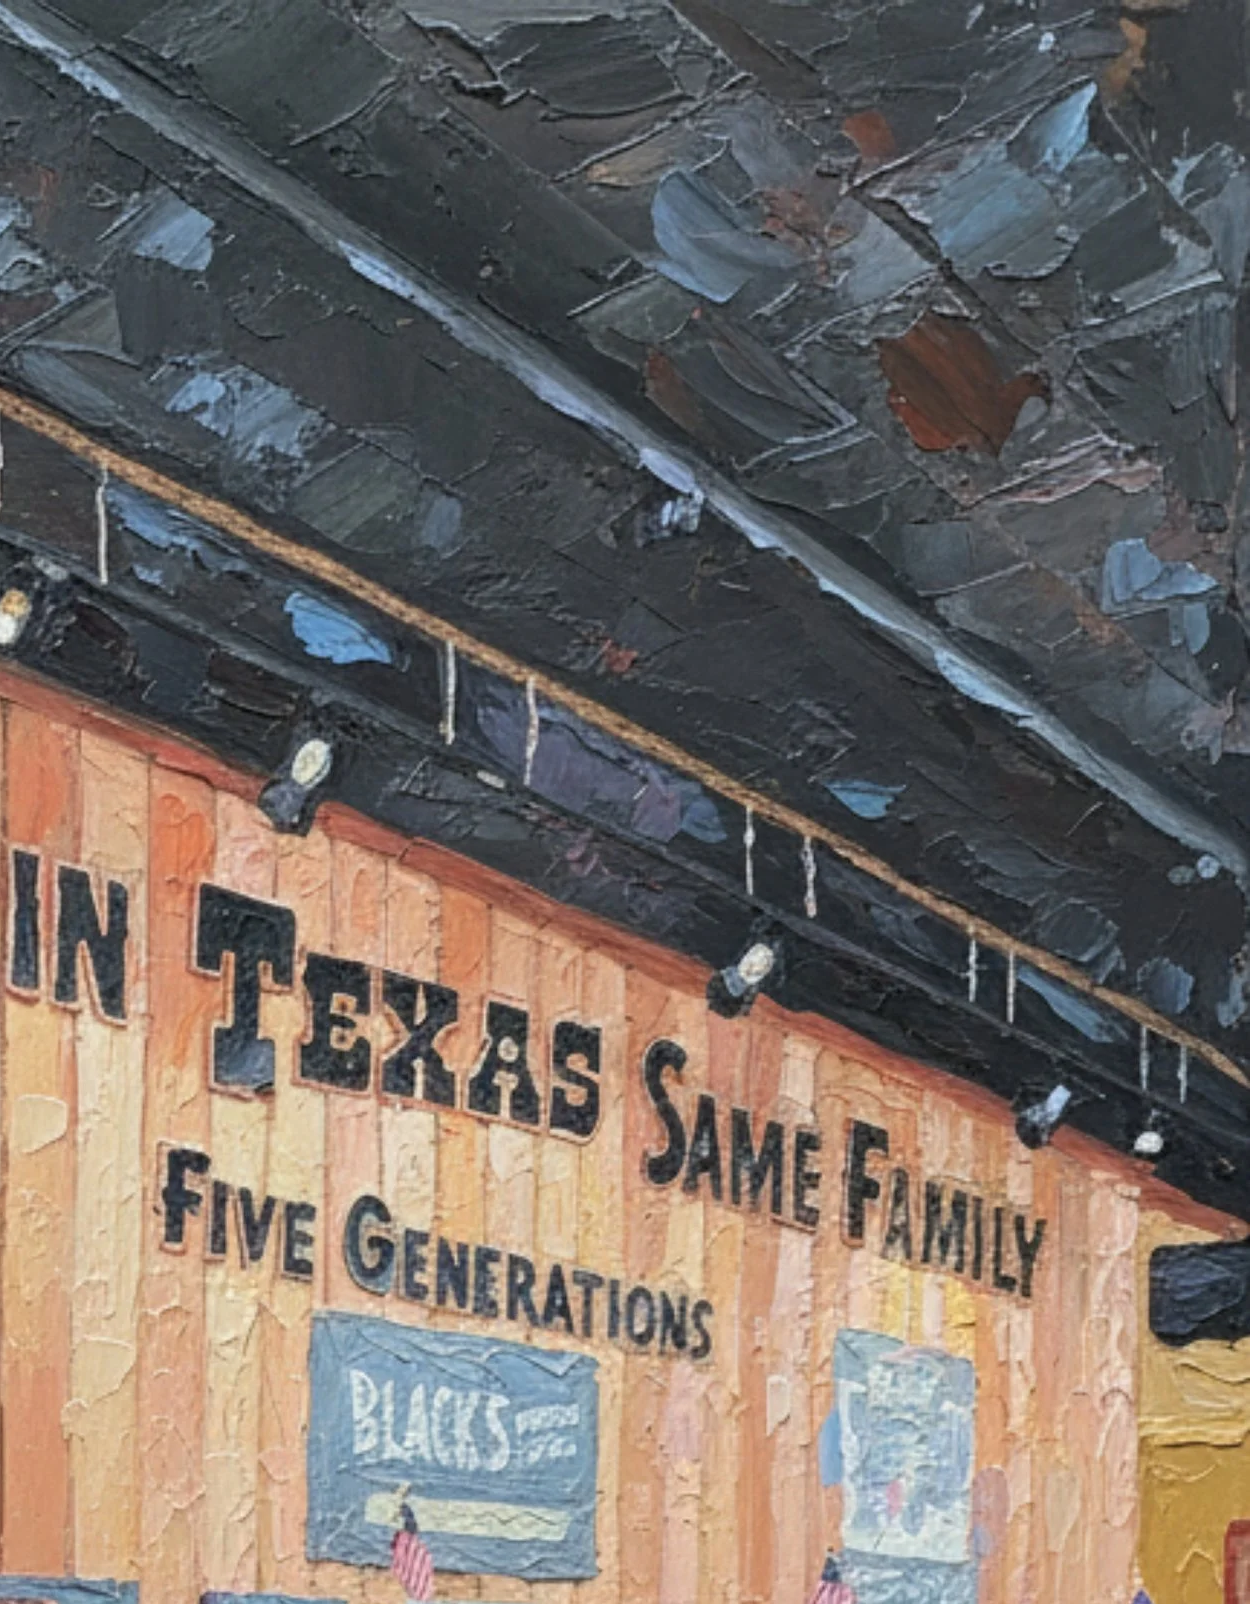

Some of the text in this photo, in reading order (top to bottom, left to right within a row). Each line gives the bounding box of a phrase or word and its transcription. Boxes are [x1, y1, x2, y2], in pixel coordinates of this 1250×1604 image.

[7, 847, 130, 1023] IN
[194, 883, 602, 1141] TEXAS
[644, 1038, 822, 1232] SAME
[844, 1117, 1048, 1298] FAMILY
[158, 1147, 715, 1361] FIVE GENERATIONS
